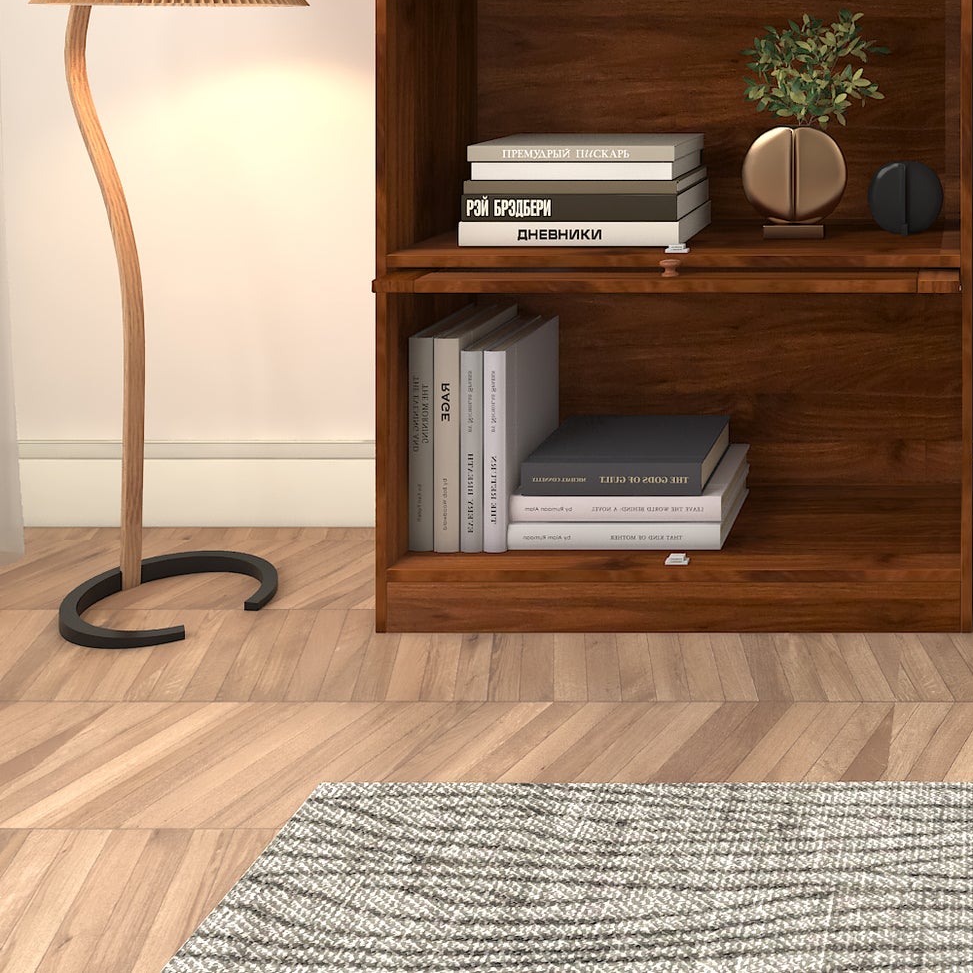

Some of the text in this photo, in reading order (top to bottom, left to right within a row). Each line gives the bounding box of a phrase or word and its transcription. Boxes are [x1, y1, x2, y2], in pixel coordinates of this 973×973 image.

[502, 148, 570, 159] ПРЕМУДРЫЙ
[466, 196, 552, 218] РЭЙ БРЭДБЕРИ
[517, 229, 602, 241] ДНЕВНИКИ
